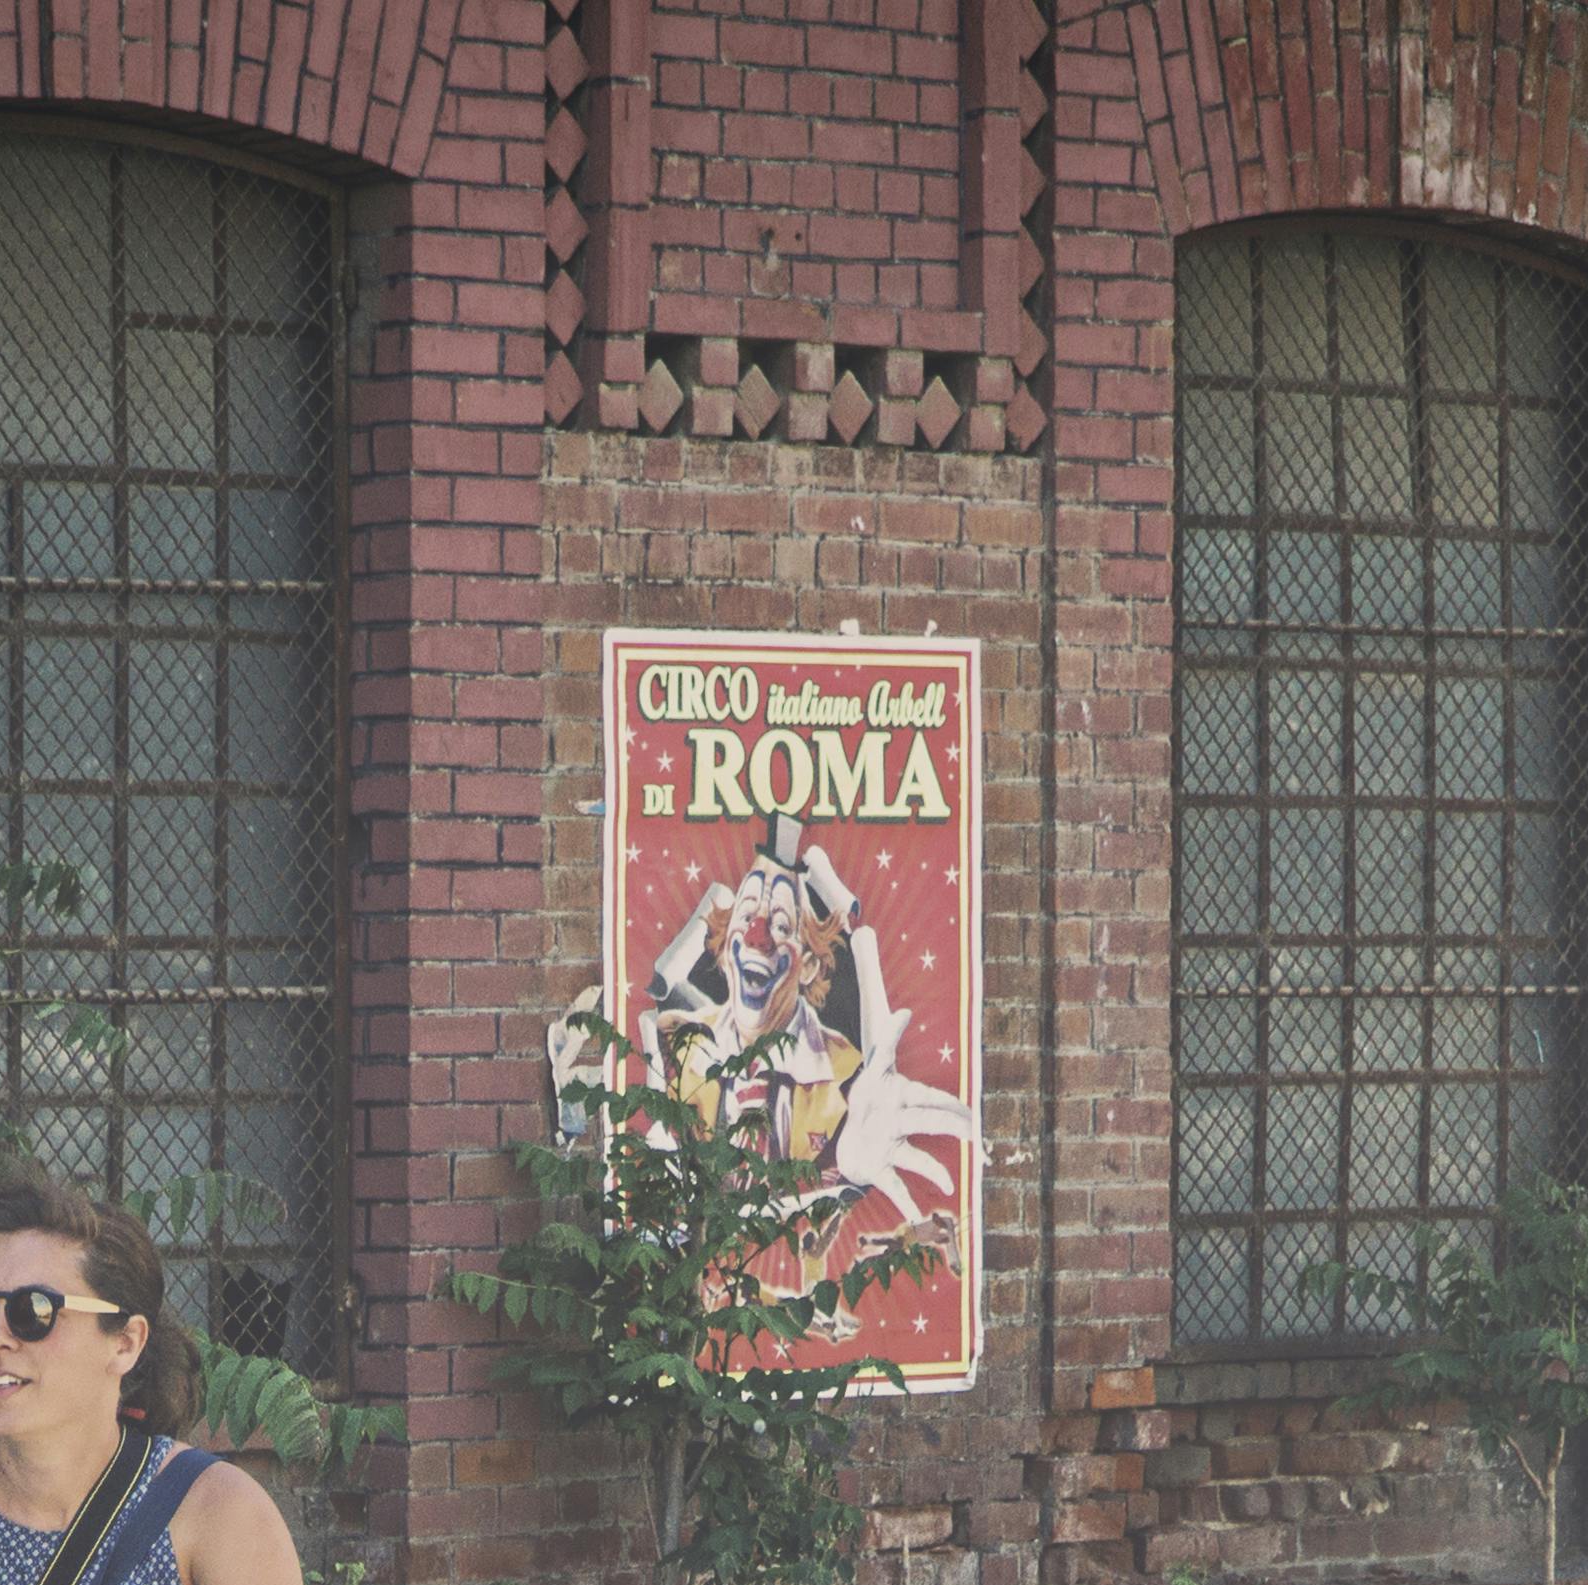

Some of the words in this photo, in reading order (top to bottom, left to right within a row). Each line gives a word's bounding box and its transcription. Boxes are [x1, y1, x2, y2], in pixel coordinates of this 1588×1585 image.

[638, 664, 760, 722] CIRCO
[766, 679, 864, 726] italiano
[867, 680, 946, 728] Arbell
[643, 784, 675, 816] DI
[686, 728, 952, 818] ROMA
